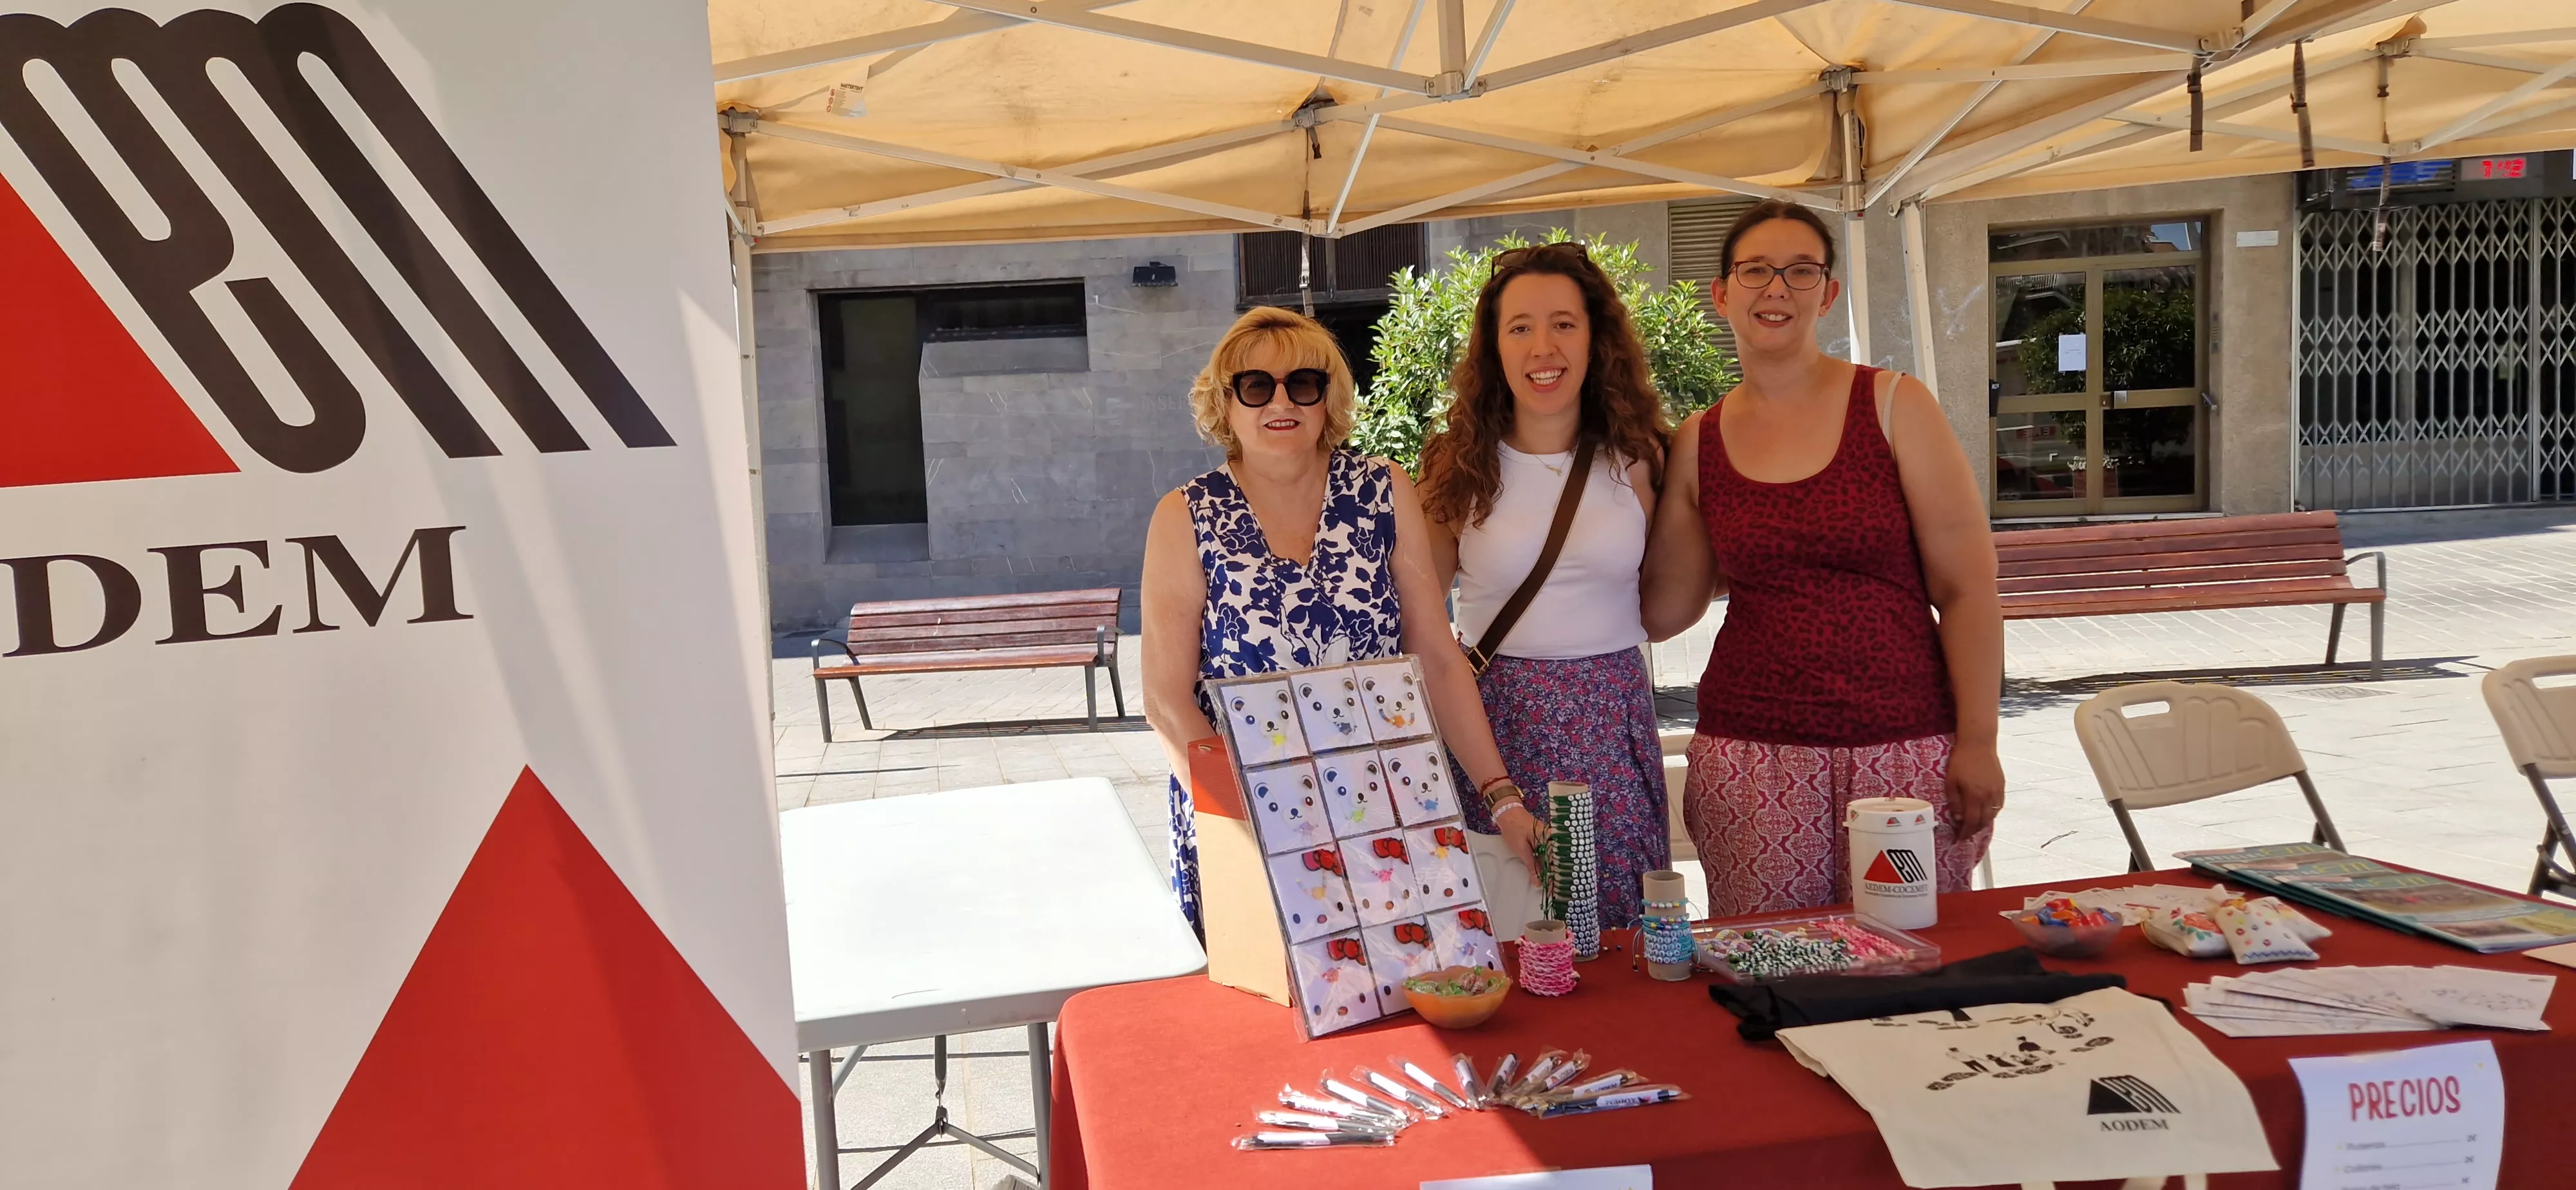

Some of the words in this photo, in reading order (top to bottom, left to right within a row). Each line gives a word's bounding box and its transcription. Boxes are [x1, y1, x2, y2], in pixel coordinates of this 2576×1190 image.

[840, 82, 864, 91] MASTERTENT
[2348, 1075, 2461, 1122] PRECIOS
[2101, 1119, 2170, 1131] AODEM
